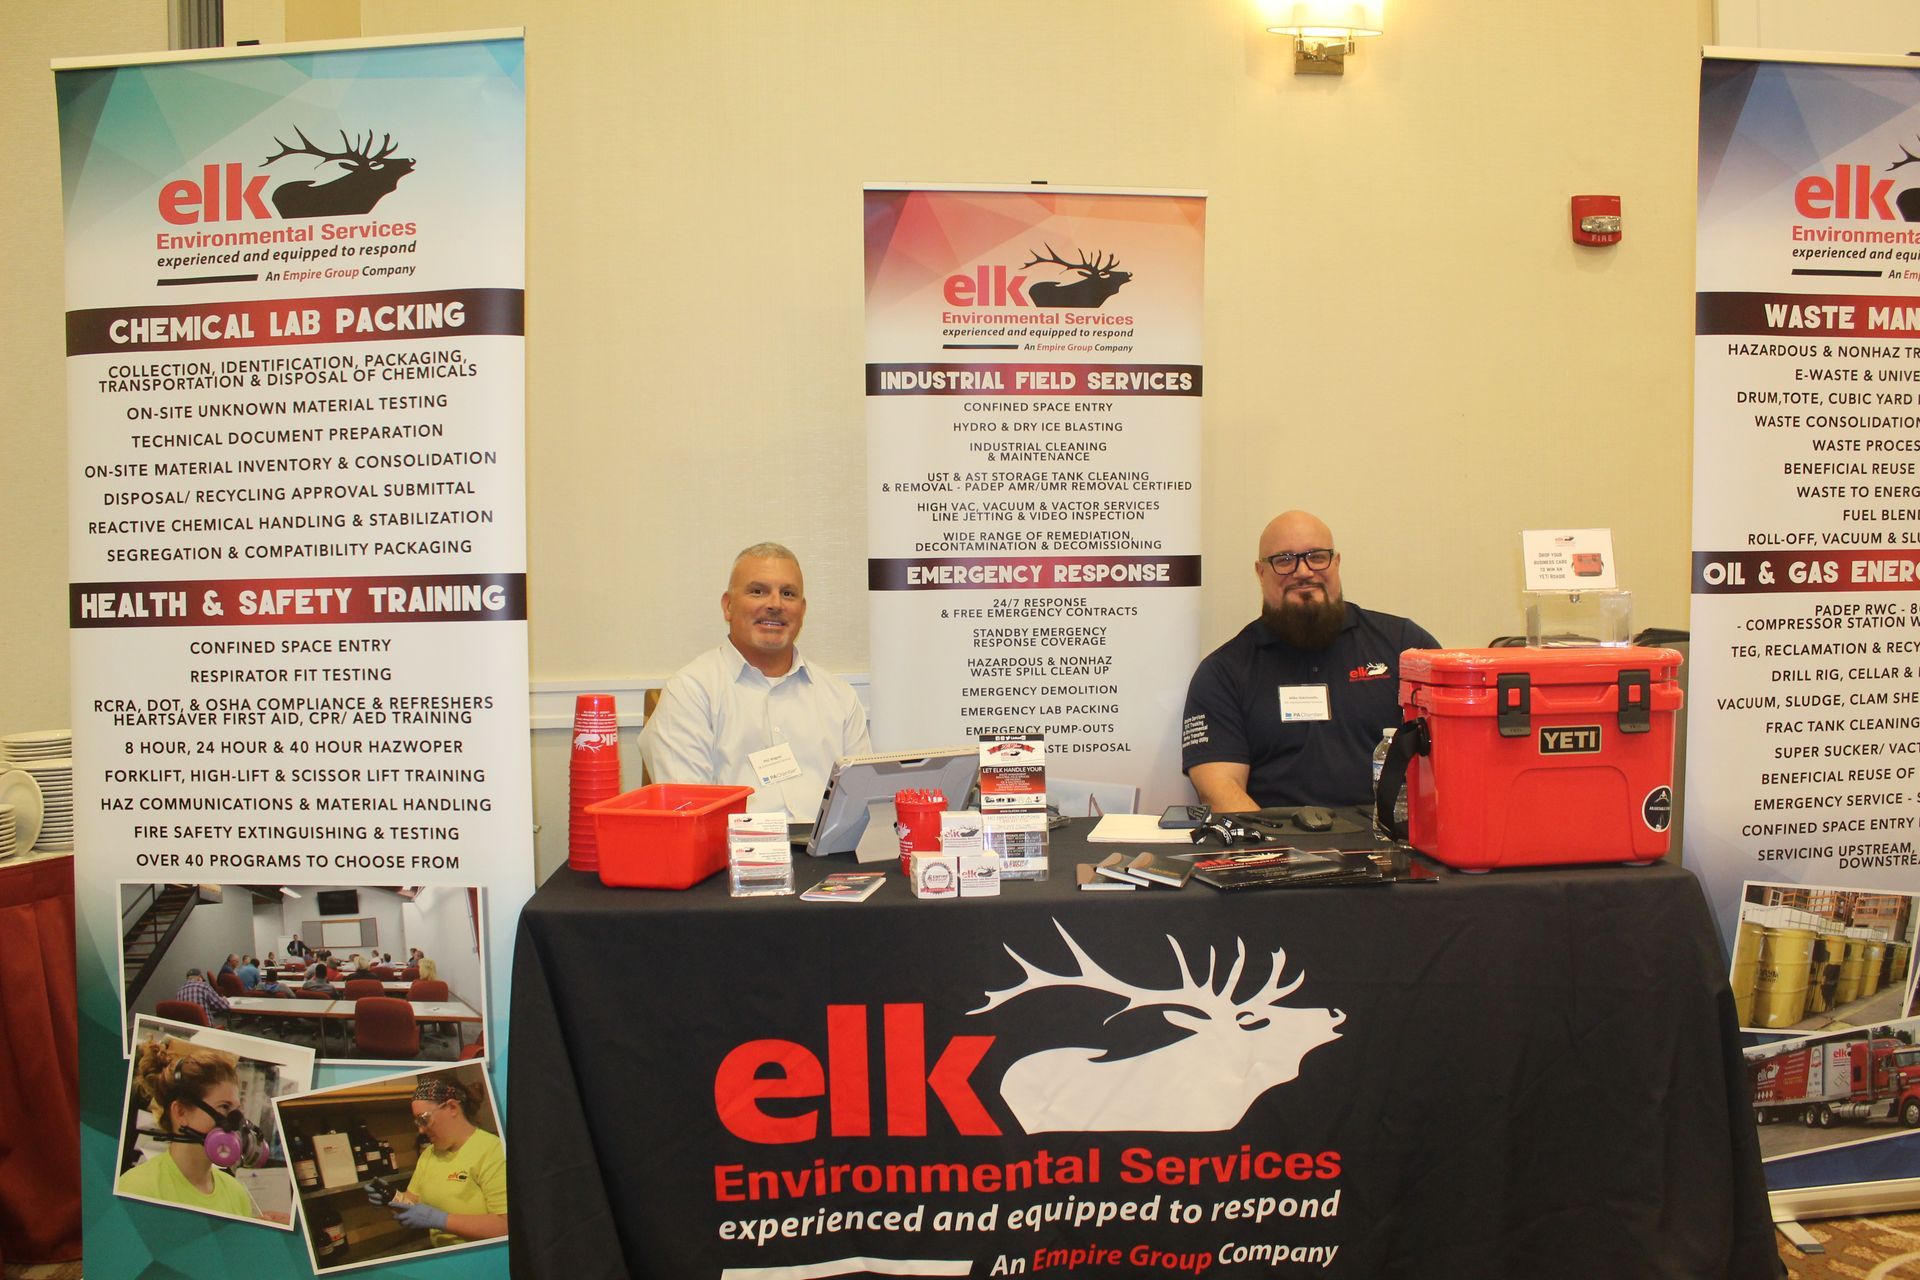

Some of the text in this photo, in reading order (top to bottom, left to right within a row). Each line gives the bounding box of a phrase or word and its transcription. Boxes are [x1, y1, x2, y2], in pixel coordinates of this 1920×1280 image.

[158, 162, 272, 226] elk
[1794, 164, 1896, 220] elk
[156, 222, 416, 250] Environmental Services
[157, 240, 416, 269] experienced and equipped to respond
[1792, 246, 1866, 260] experienced
[1869, 248, 1893, 259] and
[264, 265, 416, 282] An Empire Group Company
[1888, 269, 1901, 278] An
[944, 265, 1028, 307] elk
[109, 301, 465, 343] CHEMICAL LAB PACKING
[942, 310, 1133, 325] Environmental Services
[1764, 303, 1855, 329] WASTE
[942, 327, 1005, 337] experienced
[1007, 327, 1027, 335] and
[1029, 327, 1077, 338] equipped
[1092, 328, 1133, 338] respond
[1036, 343, 1065, 352] Empire
[1067, 343, 1092, 352] Group
[1094, 343, 1133, 353] Company
[108, 349, 466, 378] COLLECTION, IDENTIFICATION, PACKAGING,
[98, 363, 476, 392] TRANSPORTATION & DISPOSAL OF CHEMICALS
[880, 371, 1191, 390] INDUSTRIAL FIELD SERVICES
[963, 402, 1112, 411] CONFINED SPACE ENTRY
[131, 424, 442, 448] TECHNICAL DOCUMENT PREPARATION
[969, 442, 1106, 451] INDUSTRIAL CLEANING
[1812, 439, 1860, 451] WASTE
[1784, 462, 1915, 474] BENEFICIAL REUSE
[1796, 486, 1845, 497] WASTE
[1850, 486, 1869, 497] TO
[107, 539, 471, 562] SEGREGATION & COMPATIBILITY PACKAGING
[915, 540, 1161, 551] DECONTAMINATION & DECOMISSIONING
[906, 563, 1169, 584] EMERGENCY RESPONSE
[1702, 559, 1920, 585] OIL & GAS ENER
[81, 581, 506, 618] HEALTH & SAFETY TRAINING
[973, 626, 1106, 637] STANDBY EMERGENCY
[190, 639, 391, 654] CONFINED SPACE ENTRY
[973, 636, 1105, 647] RESPONSE COVERAGE
[190, 667, 391, 682] RESPIRATOR FIT TESTING
[1349, 666, 1369, 678] elk
[962, 685, 1117, 696] EMERGENCY DEMOLITION
[960, 704, 1118, 716] EMERGENCY LAB PACKING
[1766, 716, 1919, 733] FRAC TANK CLEANING
[1543, 731, 1596, 749] YETI
[1761, 767, 1915, 784] BENEFICIAL REUSE OF
[1757, 842, 1915, 860] SERVICING UPSTREAM,
[136, 853, 458, 868] OVER 40 PROGRAMS TO CHOOSE FROM
[714, 1002, 1002, 1144] elk
[714, 1144, 1340, 1201] Environmental Services
[718, 1189, 1340, 1246] experienced and equipped to respond
[989, 1242, 1338, 1276] An Empire Group Company
